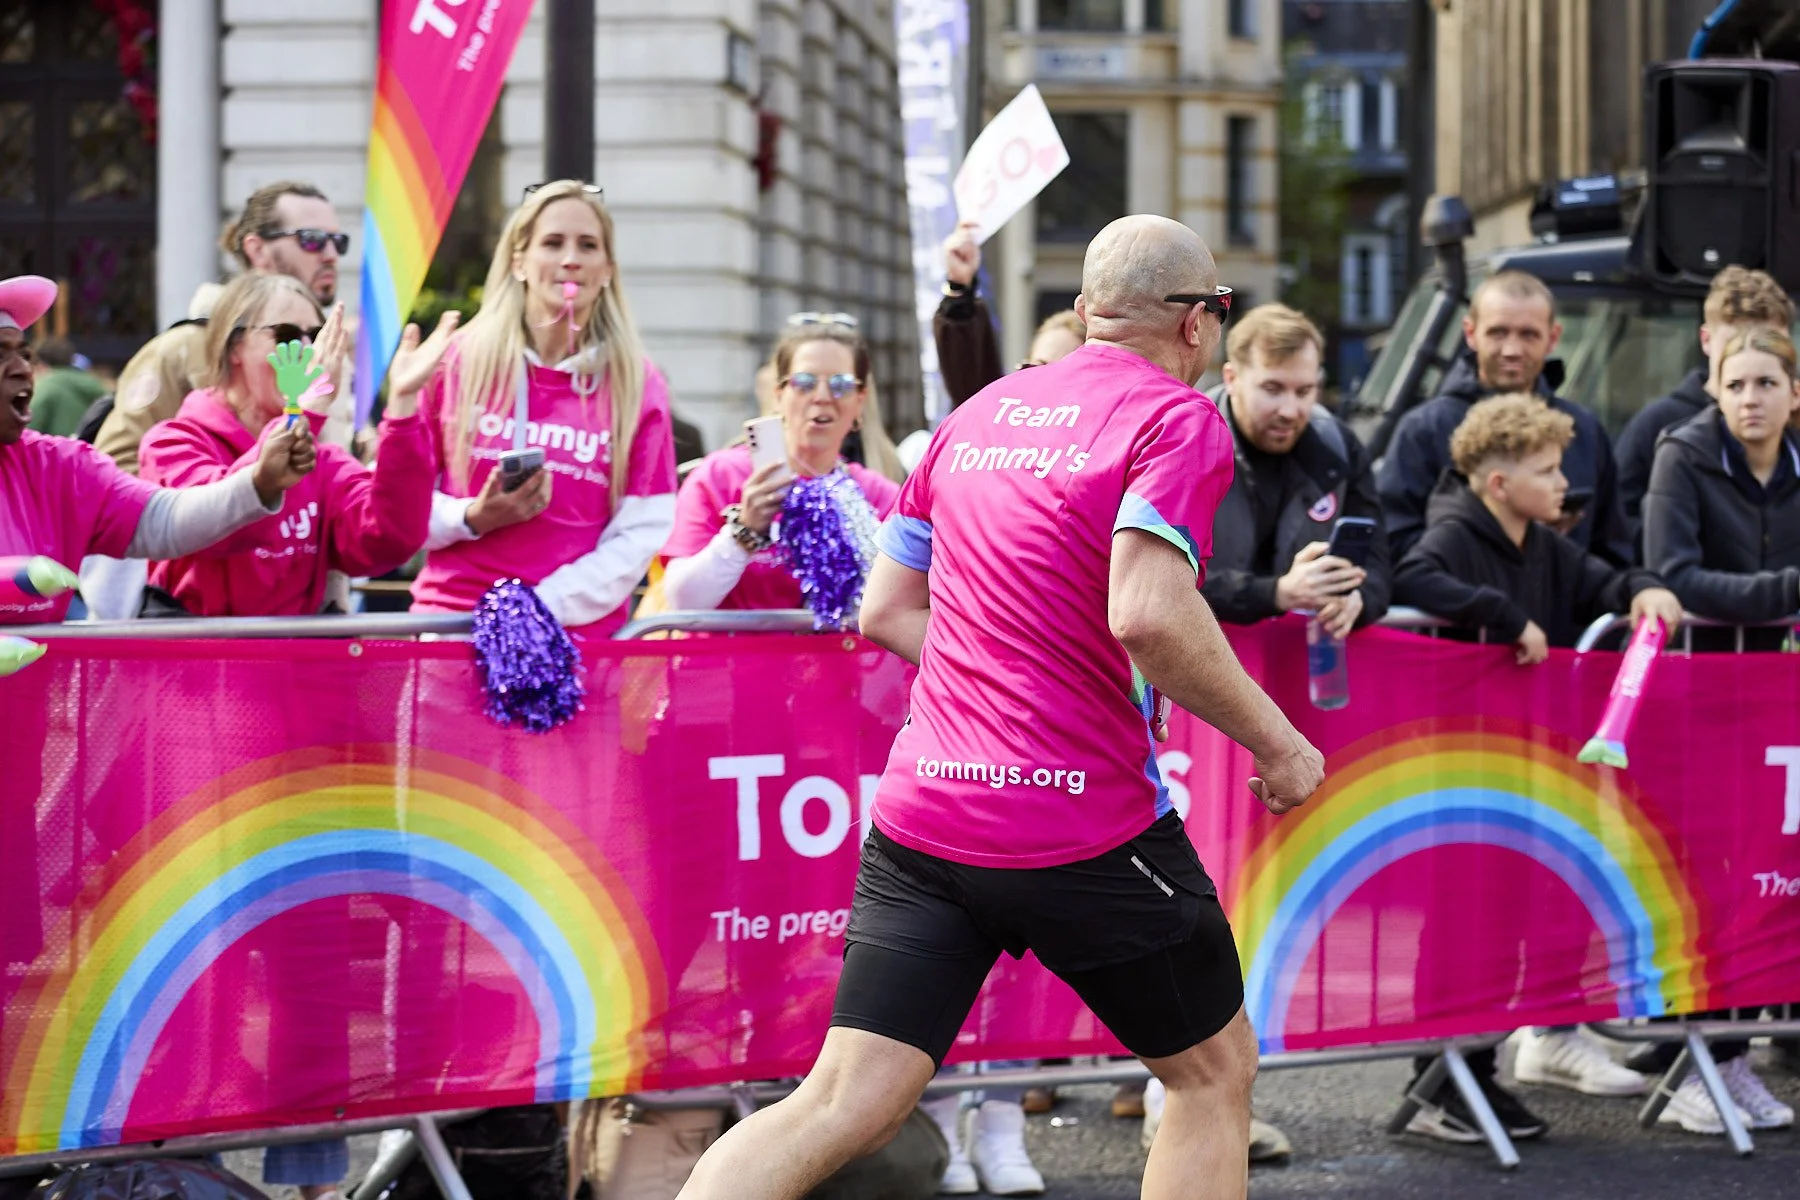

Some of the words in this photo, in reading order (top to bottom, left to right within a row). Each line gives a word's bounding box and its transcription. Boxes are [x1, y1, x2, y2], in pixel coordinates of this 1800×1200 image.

[993, 397, 1081, 428] Team
[949, 441, 1092, 480] Tommy's
[916, 755, 1086, 795] tommys.org
[711, 906, 770, 942] The
